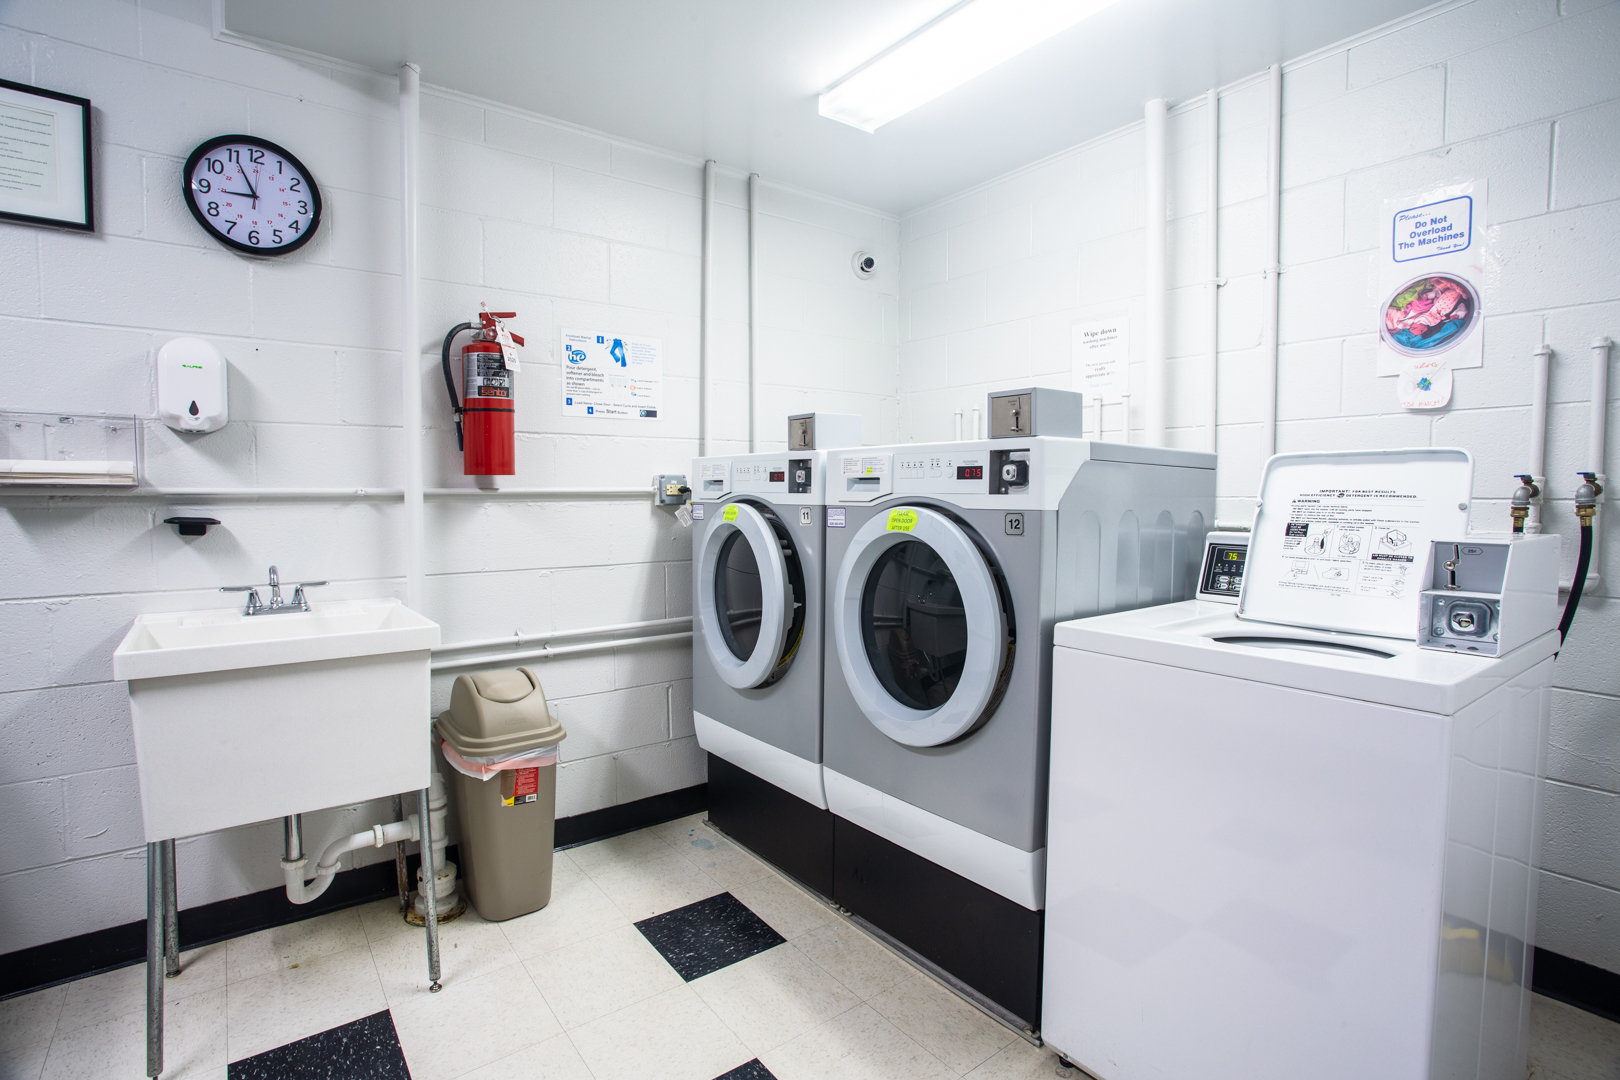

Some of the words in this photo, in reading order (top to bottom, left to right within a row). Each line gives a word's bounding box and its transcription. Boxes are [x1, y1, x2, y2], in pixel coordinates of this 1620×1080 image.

[226, 148, 240, 164] 11
[247, 148, 265, 165] 12
[205, 157, 224, 174] 10
[276, 160, 282, 174] 1
[199, 178, 211, 194] 9
[290, 178, 301, 193] 2
[207, 201, 220, 217] 8
[297, 200, 308, 215] 3
[224, 220, 237, 235] 7
[288, 220, 300, 234] 4
[1415, 221, 1427, 229] Do
[1430, 216, 1448, 226] Not
[248, 230, 260, 245] 6
[272, 228, 283, 244] 5
[1410, 223, 1452, 239] Overload
[1398, 241, 1415, 250] The
[1418, 231, 1465, 246] Machines
[481, 388, 507, 396] sentry
[1009, 519, 1020, 529] 12
